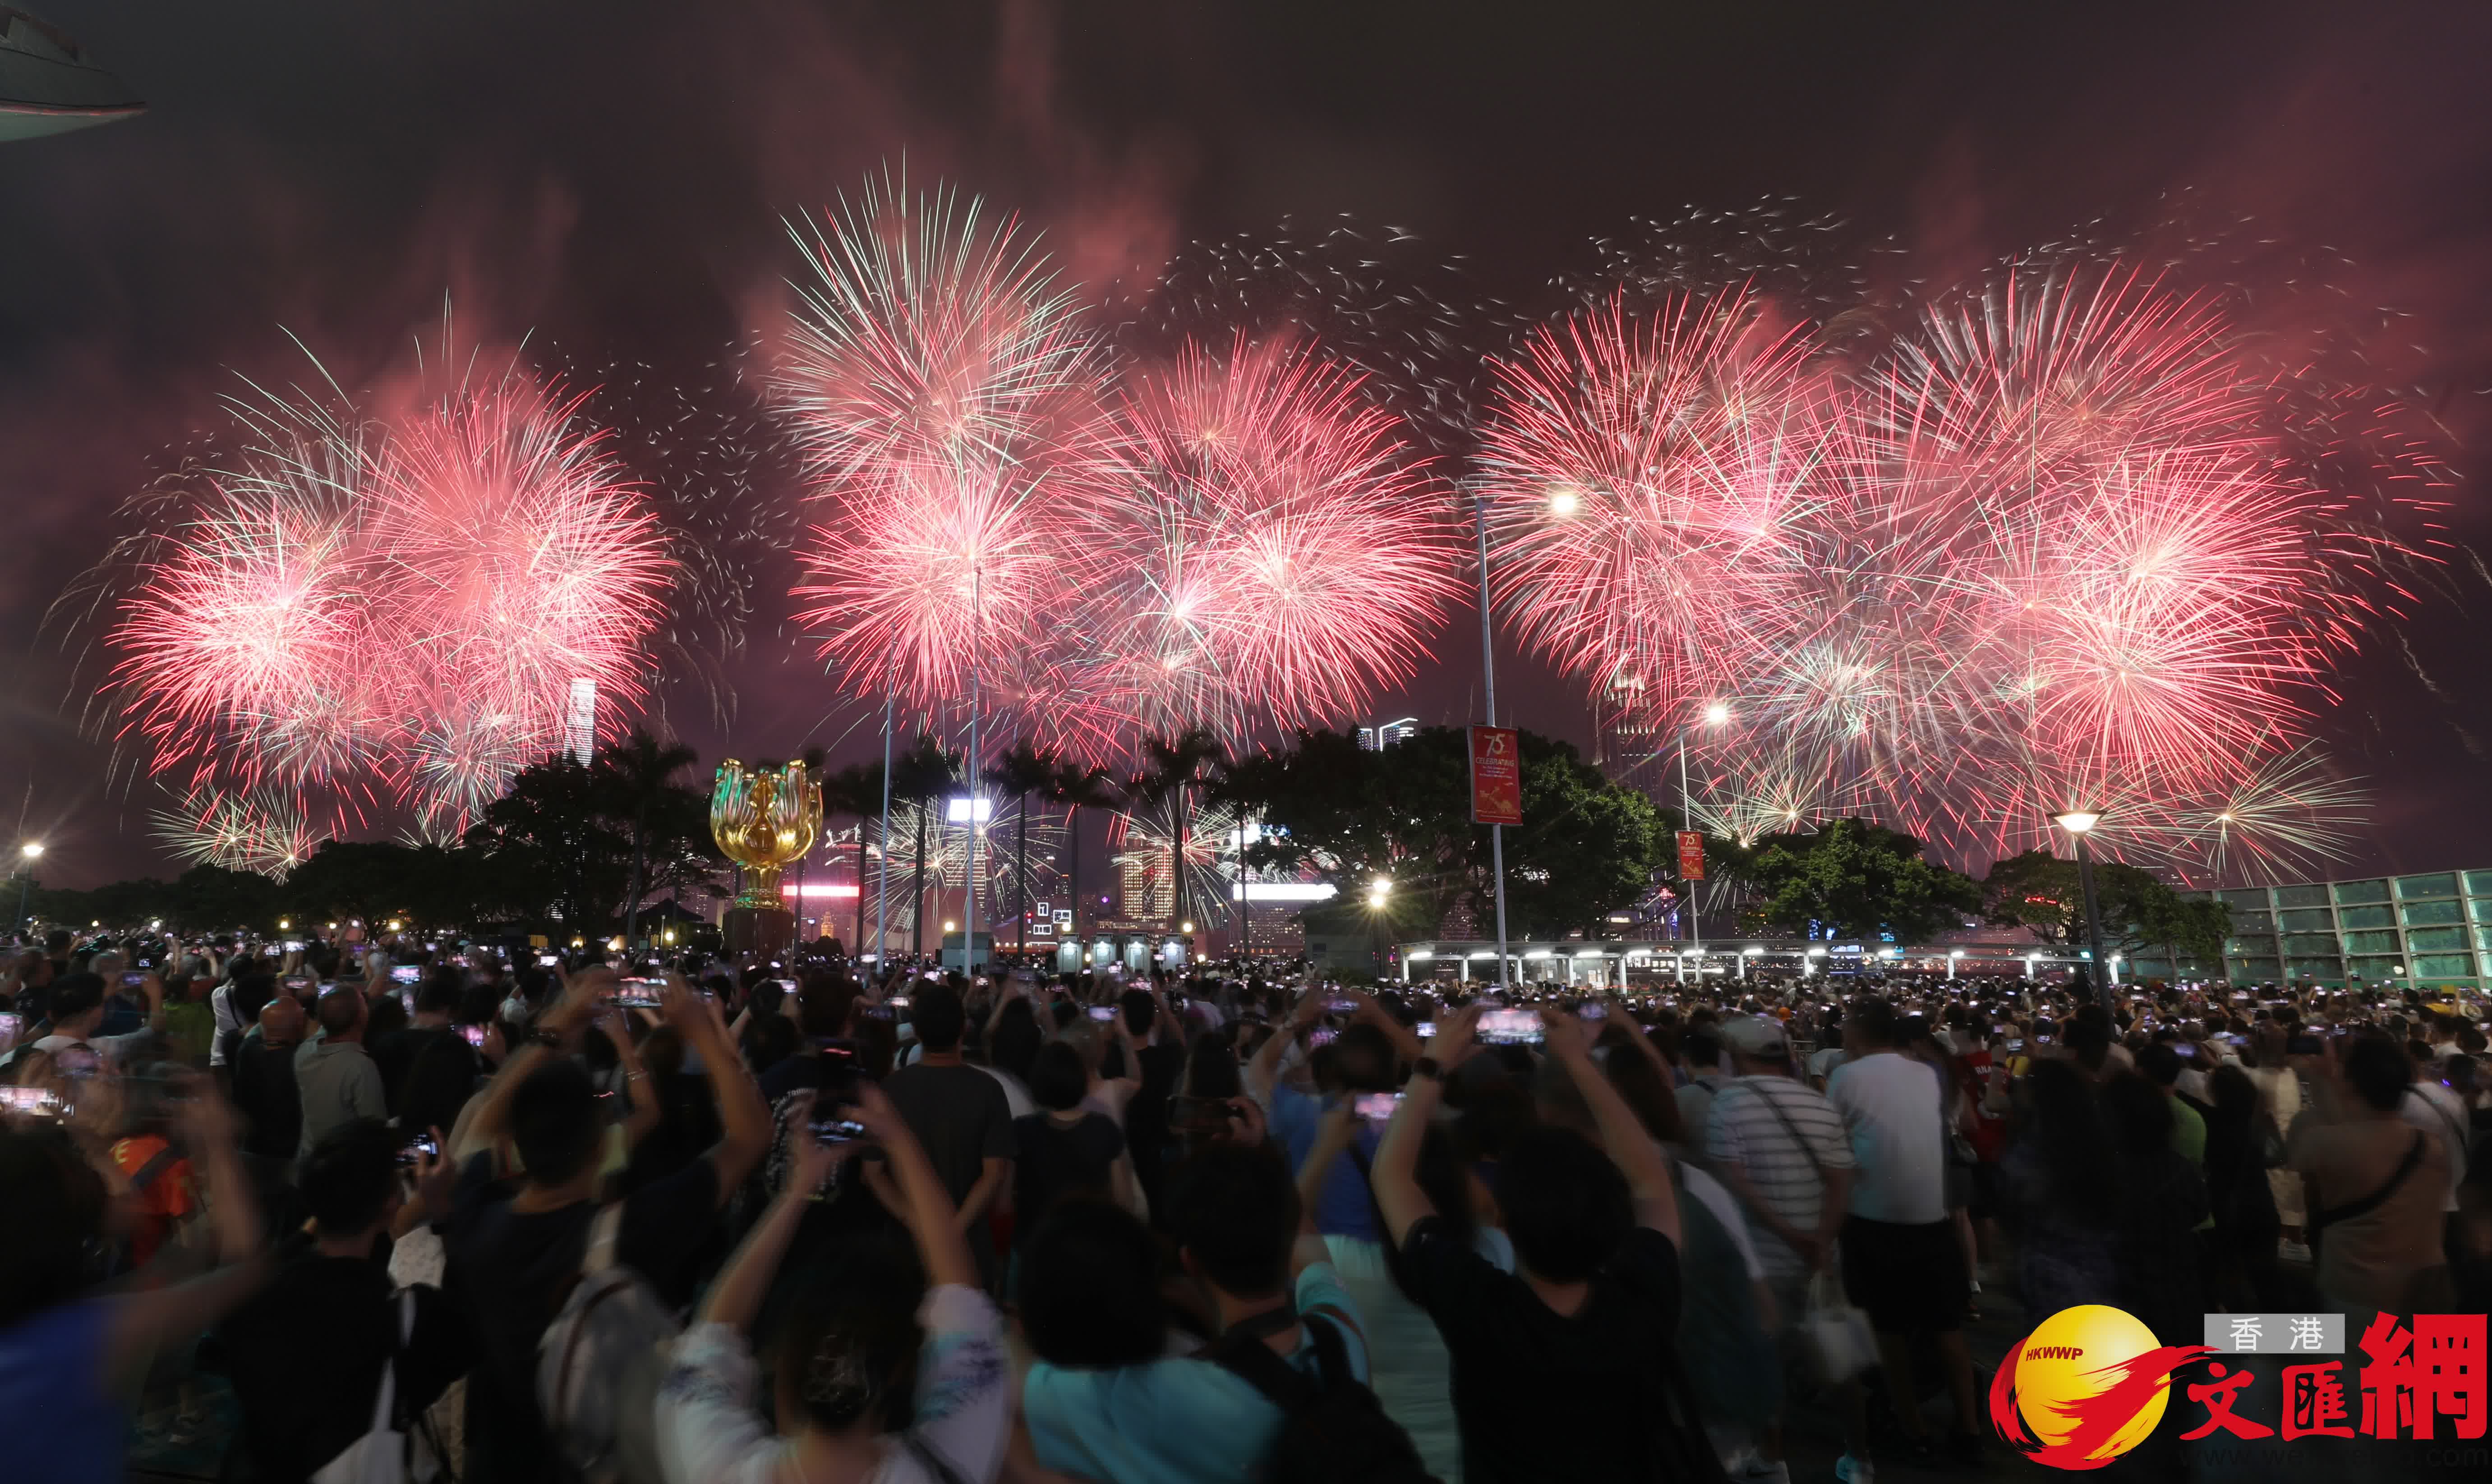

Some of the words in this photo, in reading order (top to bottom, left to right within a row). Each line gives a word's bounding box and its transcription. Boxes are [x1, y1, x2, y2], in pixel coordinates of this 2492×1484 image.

[1483, 733, 1505, 757] 75
[1475, 757, 1515, 767] CELEBRATING
[1684, 834, 1696, 846] 75
